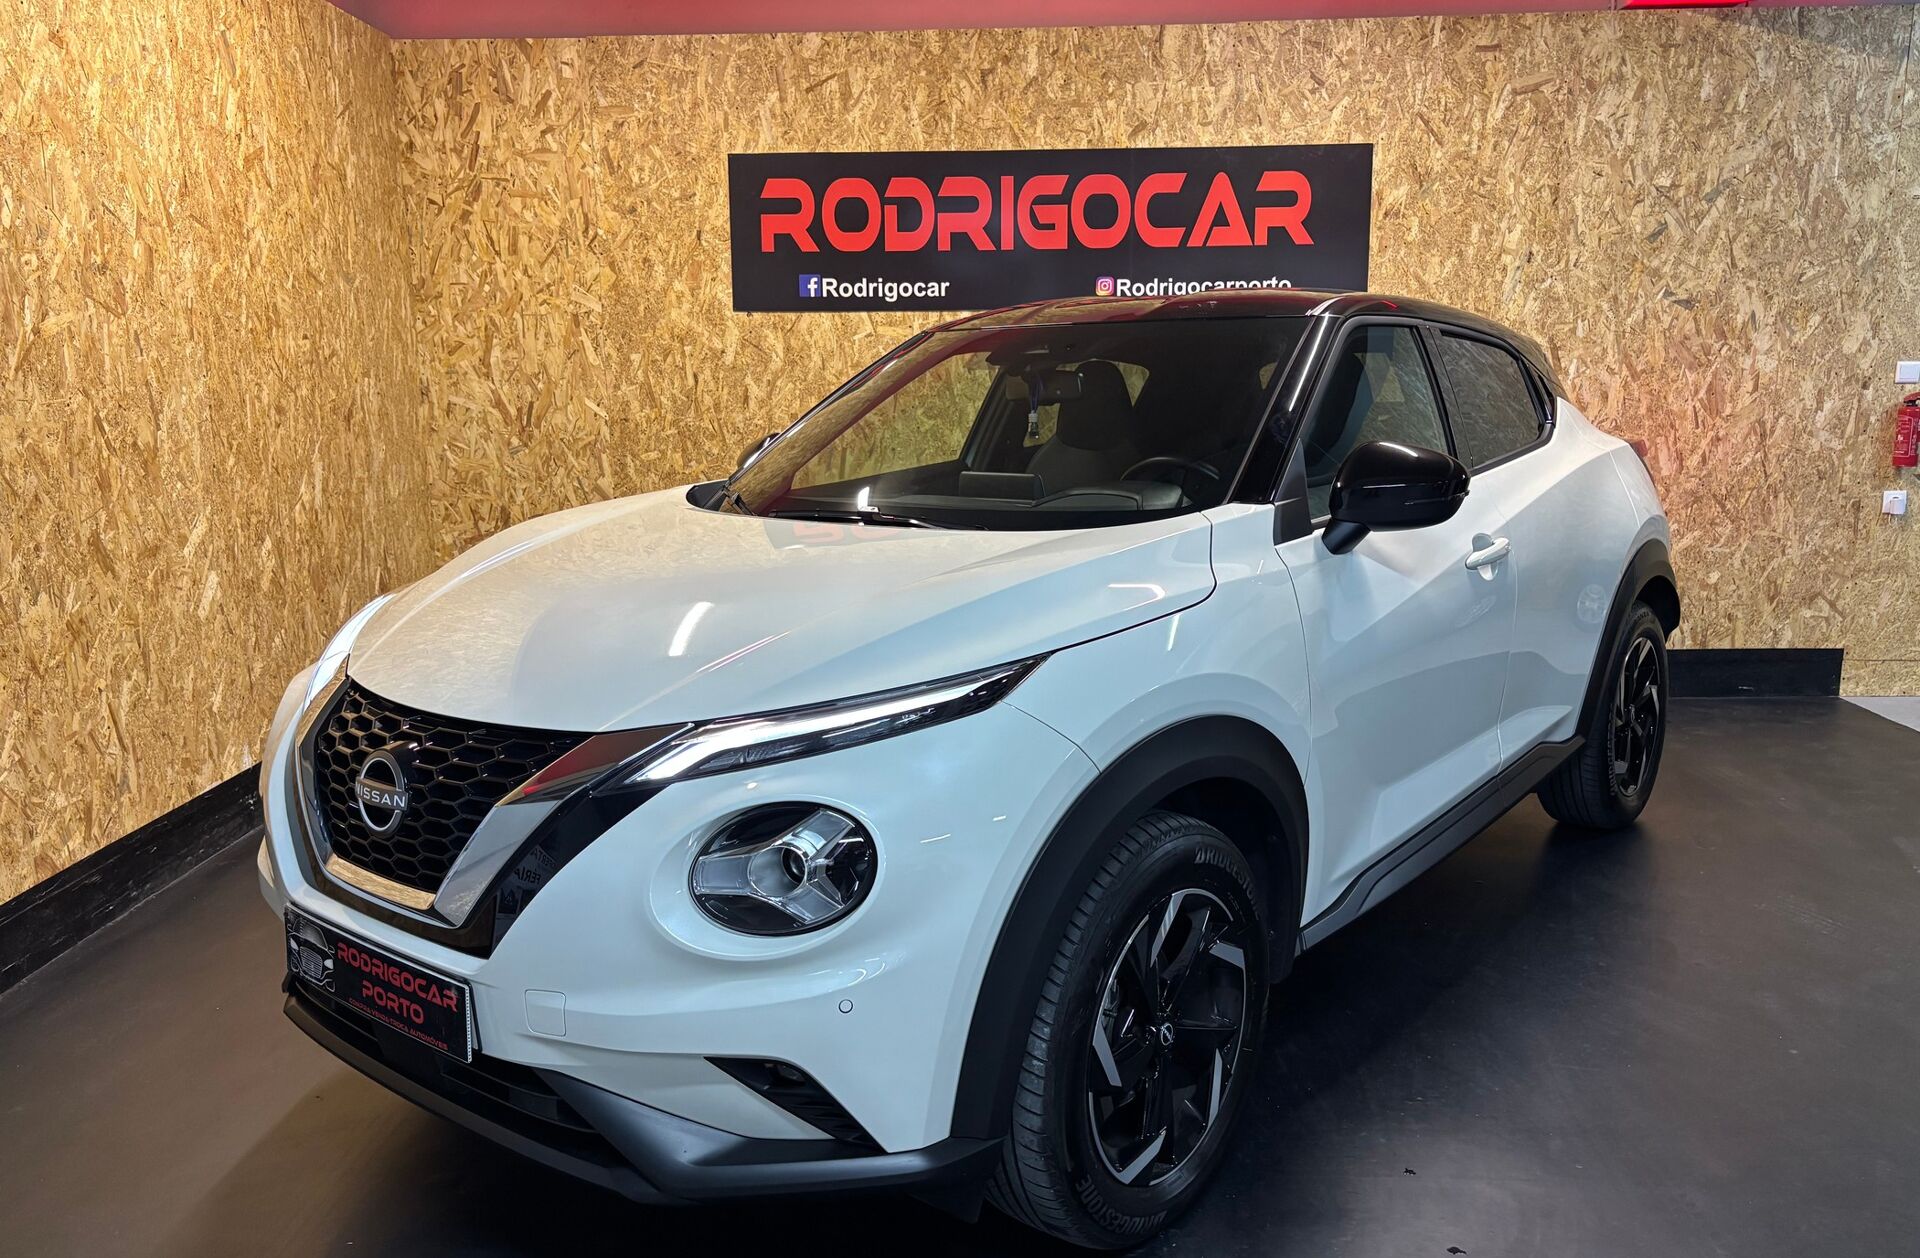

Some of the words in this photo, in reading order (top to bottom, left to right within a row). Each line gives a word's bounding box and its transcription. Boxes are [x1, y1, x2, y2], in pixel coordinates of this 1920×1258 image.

[760, 170, 1314, 252] RODRIGOCAR
[822, 278, 949, 302] Rodrigocar
[355, 782, 406, 807] NISSAN
[337, 942, 457, 1012] RODRIGOCAR
[362, 980, 424, 1024] PORTO
